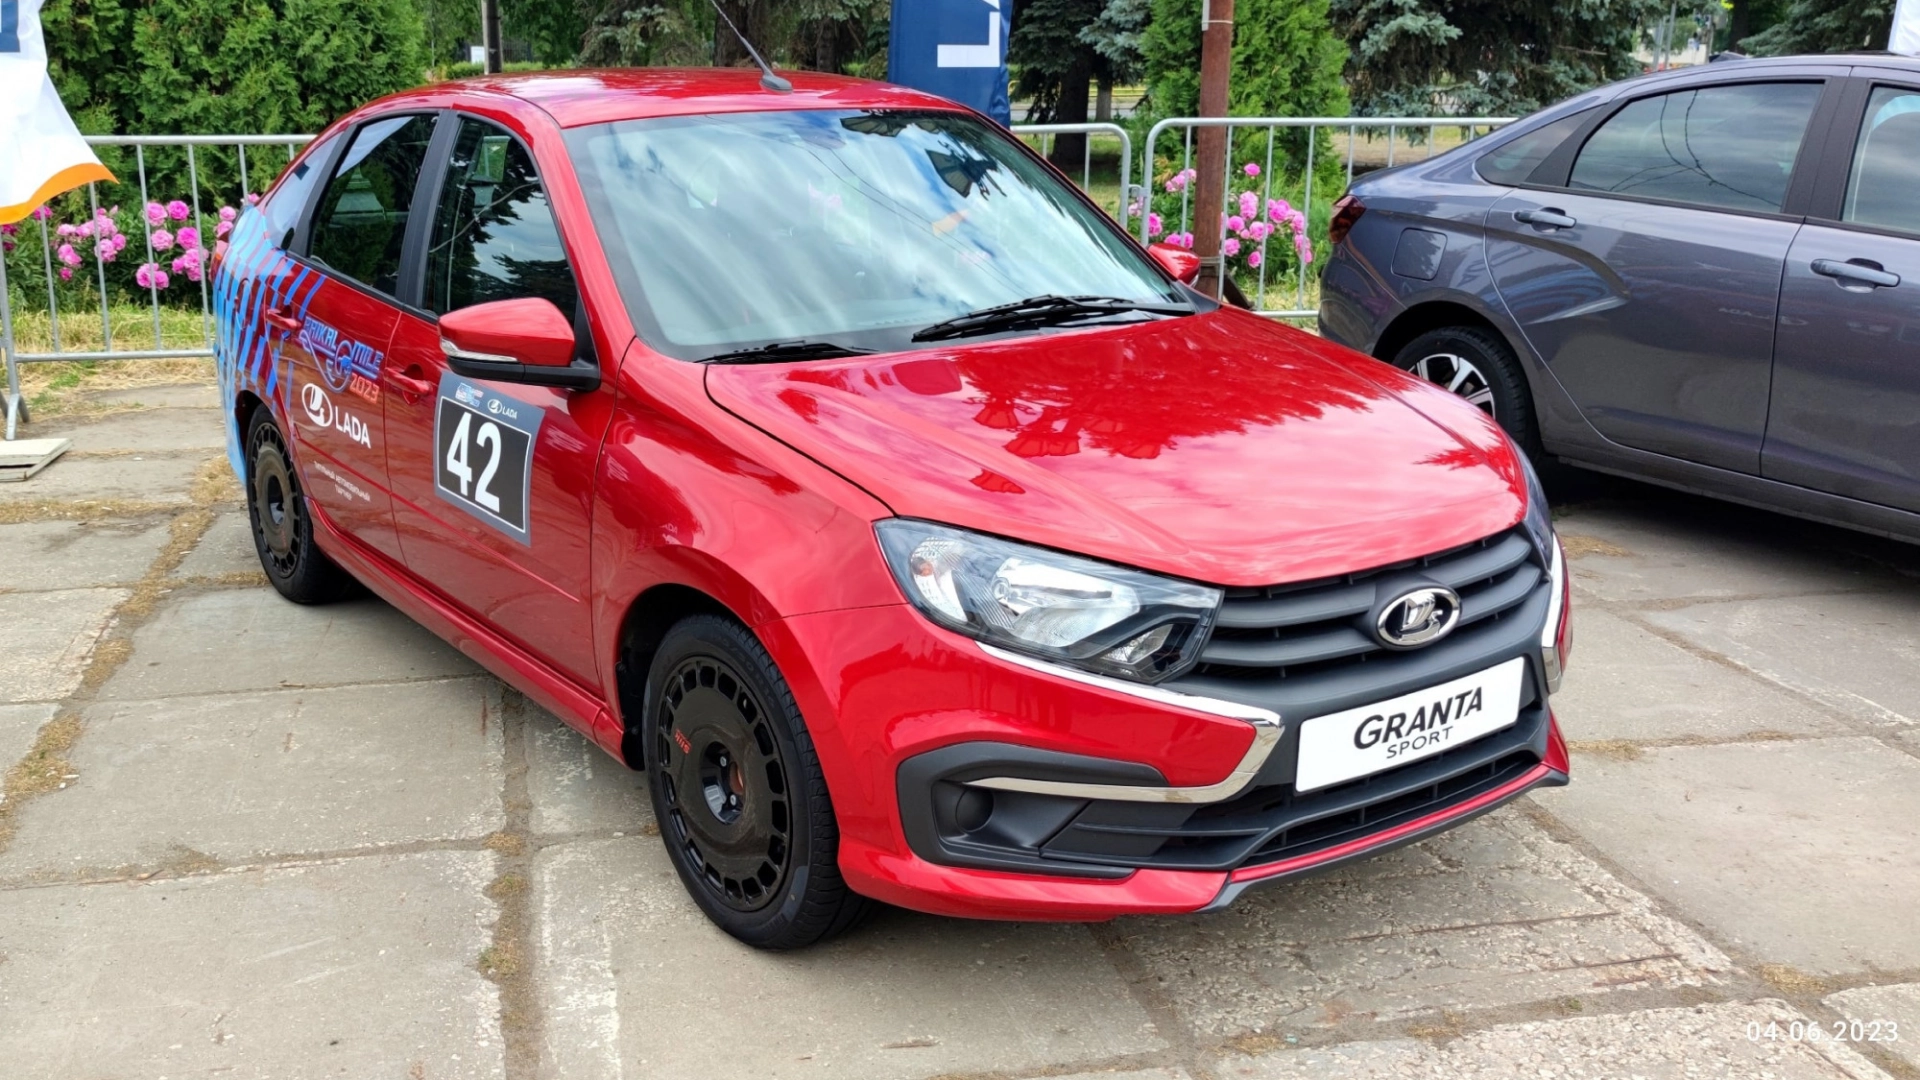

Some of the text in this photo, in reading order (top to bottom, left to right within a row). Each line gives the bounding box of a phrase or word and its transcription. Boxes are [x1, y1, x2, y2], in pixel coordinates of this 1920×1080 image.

[351, 341, 384, 371] MILE
[349, 372, 380, 404] 2023
[335, 406, 372, 449] LADA
[446, 411, 502, 513] 42
[1353, 686, 1483, 750] GRANTA
[1386, 726, 1454, 759] SPORT
